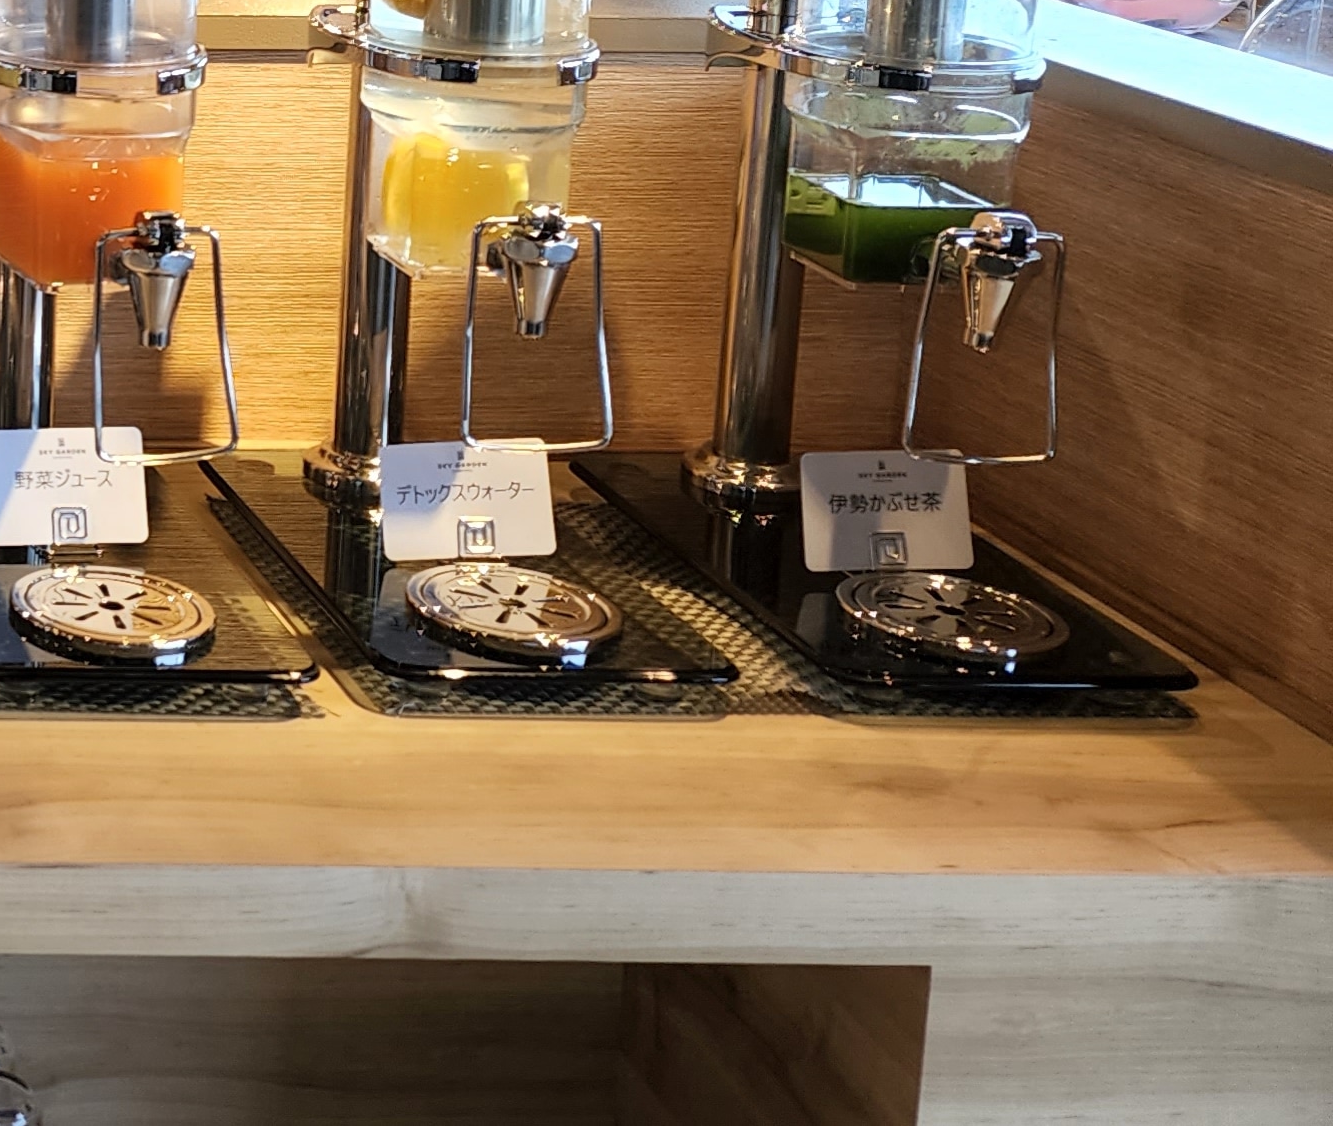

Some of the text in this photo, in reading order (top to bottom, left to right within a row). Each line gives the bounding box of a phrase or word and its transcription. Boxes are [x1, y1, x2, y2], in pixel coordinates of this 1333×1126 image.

[14, 469, 113, 490] 野菜ジュース
[396, 481, 535, 505] デトックスウォーター
[828, 492, 943, 514] 伊勢かぶせ茶
